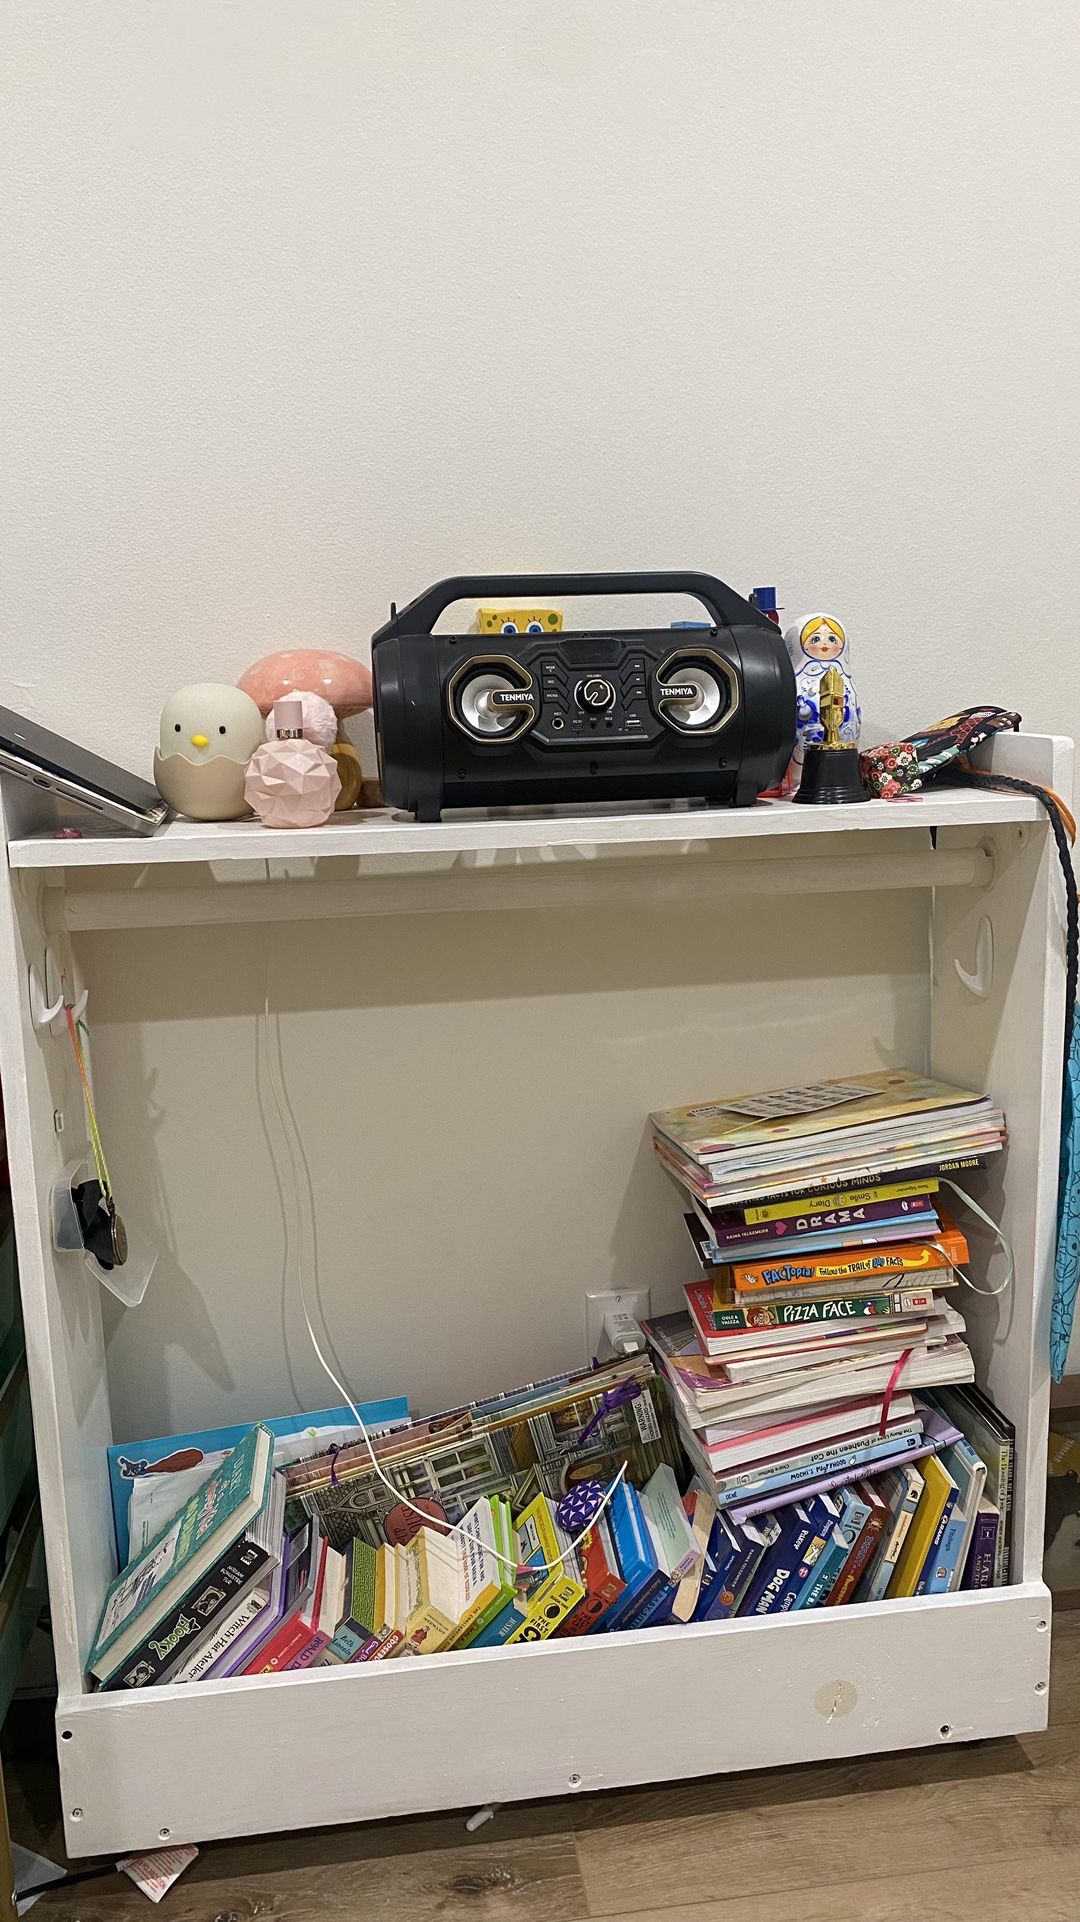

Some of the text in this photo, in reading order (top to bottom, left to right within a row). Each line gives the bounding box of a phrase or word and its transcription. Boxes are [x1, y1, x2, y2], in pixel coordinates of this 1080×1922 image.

[500, 693, 534, 702] TENMIYA
[660, 688, 694, 696] TENMIYA
[940, 1158, 980, 1172] JORDAN MOORE
[851, 1174, 881, 1186] MINDS
[809, 1199, 830, 1208] Diary
[850, 1192, 870, 1202] Smile
[837, 1264, 848, 1274] the
[848, 1260, 866, 1273] TRAIL
[822, 1300, 856, 1320] FACE
[840, 1438, 870, 1453] Pusheen
[810, 1452, 825, 1462] Cat
[826, 1448, 839, 1458] the
[934, 1523, 946, 1546] RAMS
[768, 1568, 790, 1593] DOG
[813, 1584, 824, 1598] THE
[756, 1590, 776, 1614] MAN
[424, 1618, 446, 1635] STEWART
[498, 1616, 516, 1637] JUSTER
[530, 1618, 548, 1633] FIRST
[538, 1616, 550, 1627] THE
[188, 1614, 250, 1679] Witch Hat Atelier
[300, 1637, 324, 1660] ROALD
